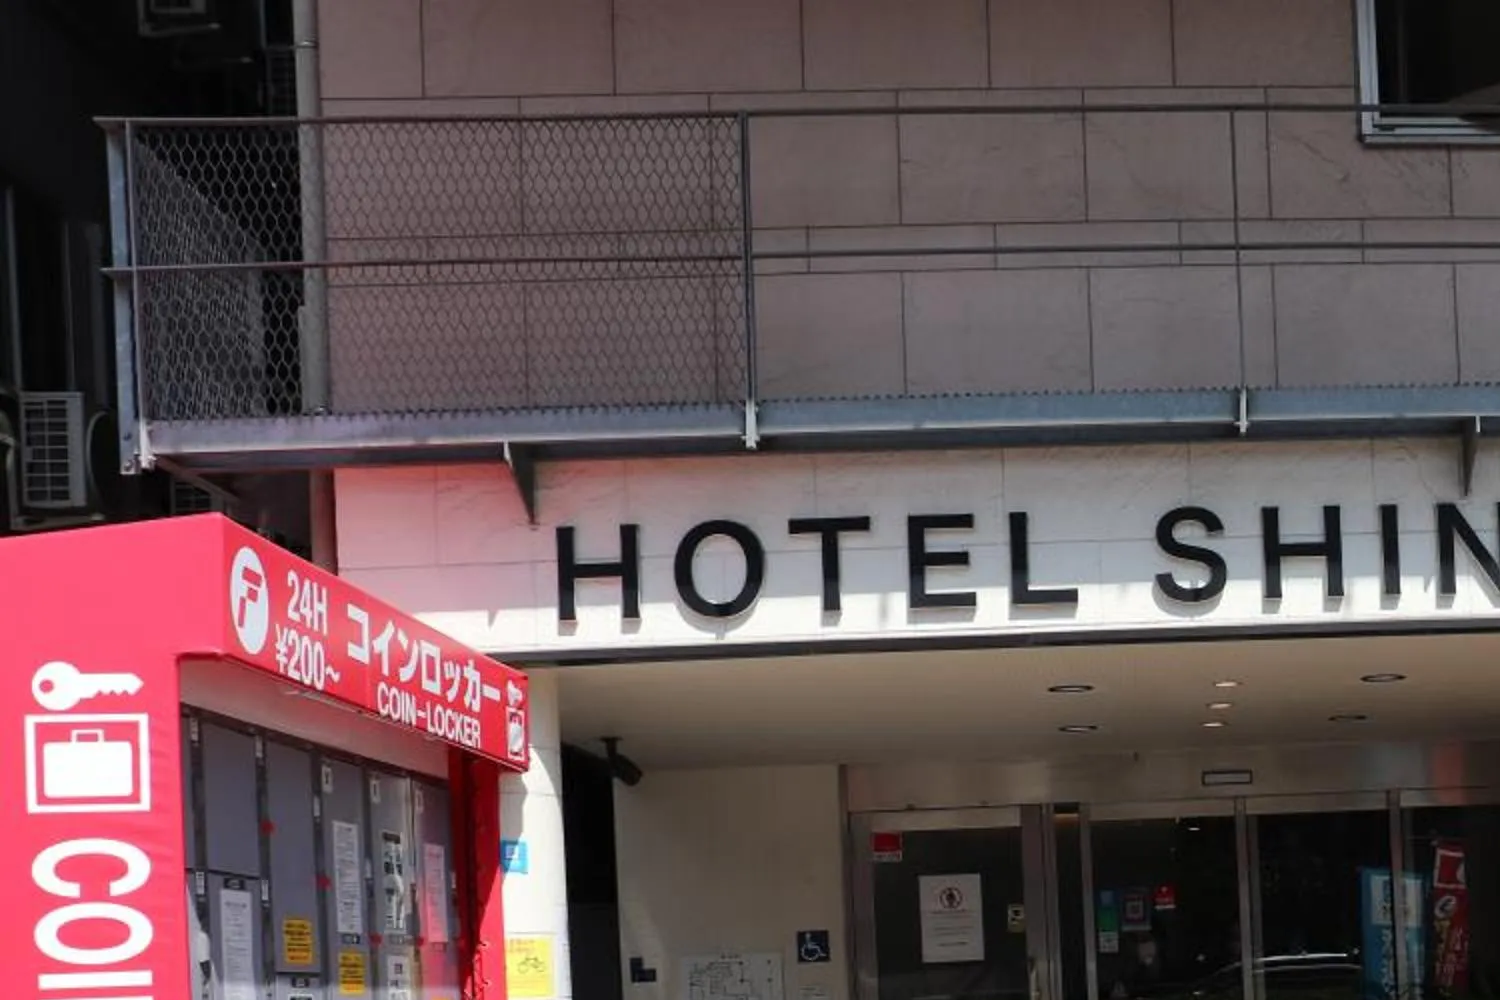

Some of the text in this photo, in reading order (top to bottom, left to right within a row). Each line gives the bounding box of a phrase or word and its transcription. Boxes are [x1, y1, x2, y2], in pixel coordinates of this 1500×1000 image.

[287, 569, 329, 636] 24H
[556, 511, 1079, 621] HOTEL
[347, 603, 501, 713] コインロッカー
[376, 681, 482, 750] COIN-LOCKER
